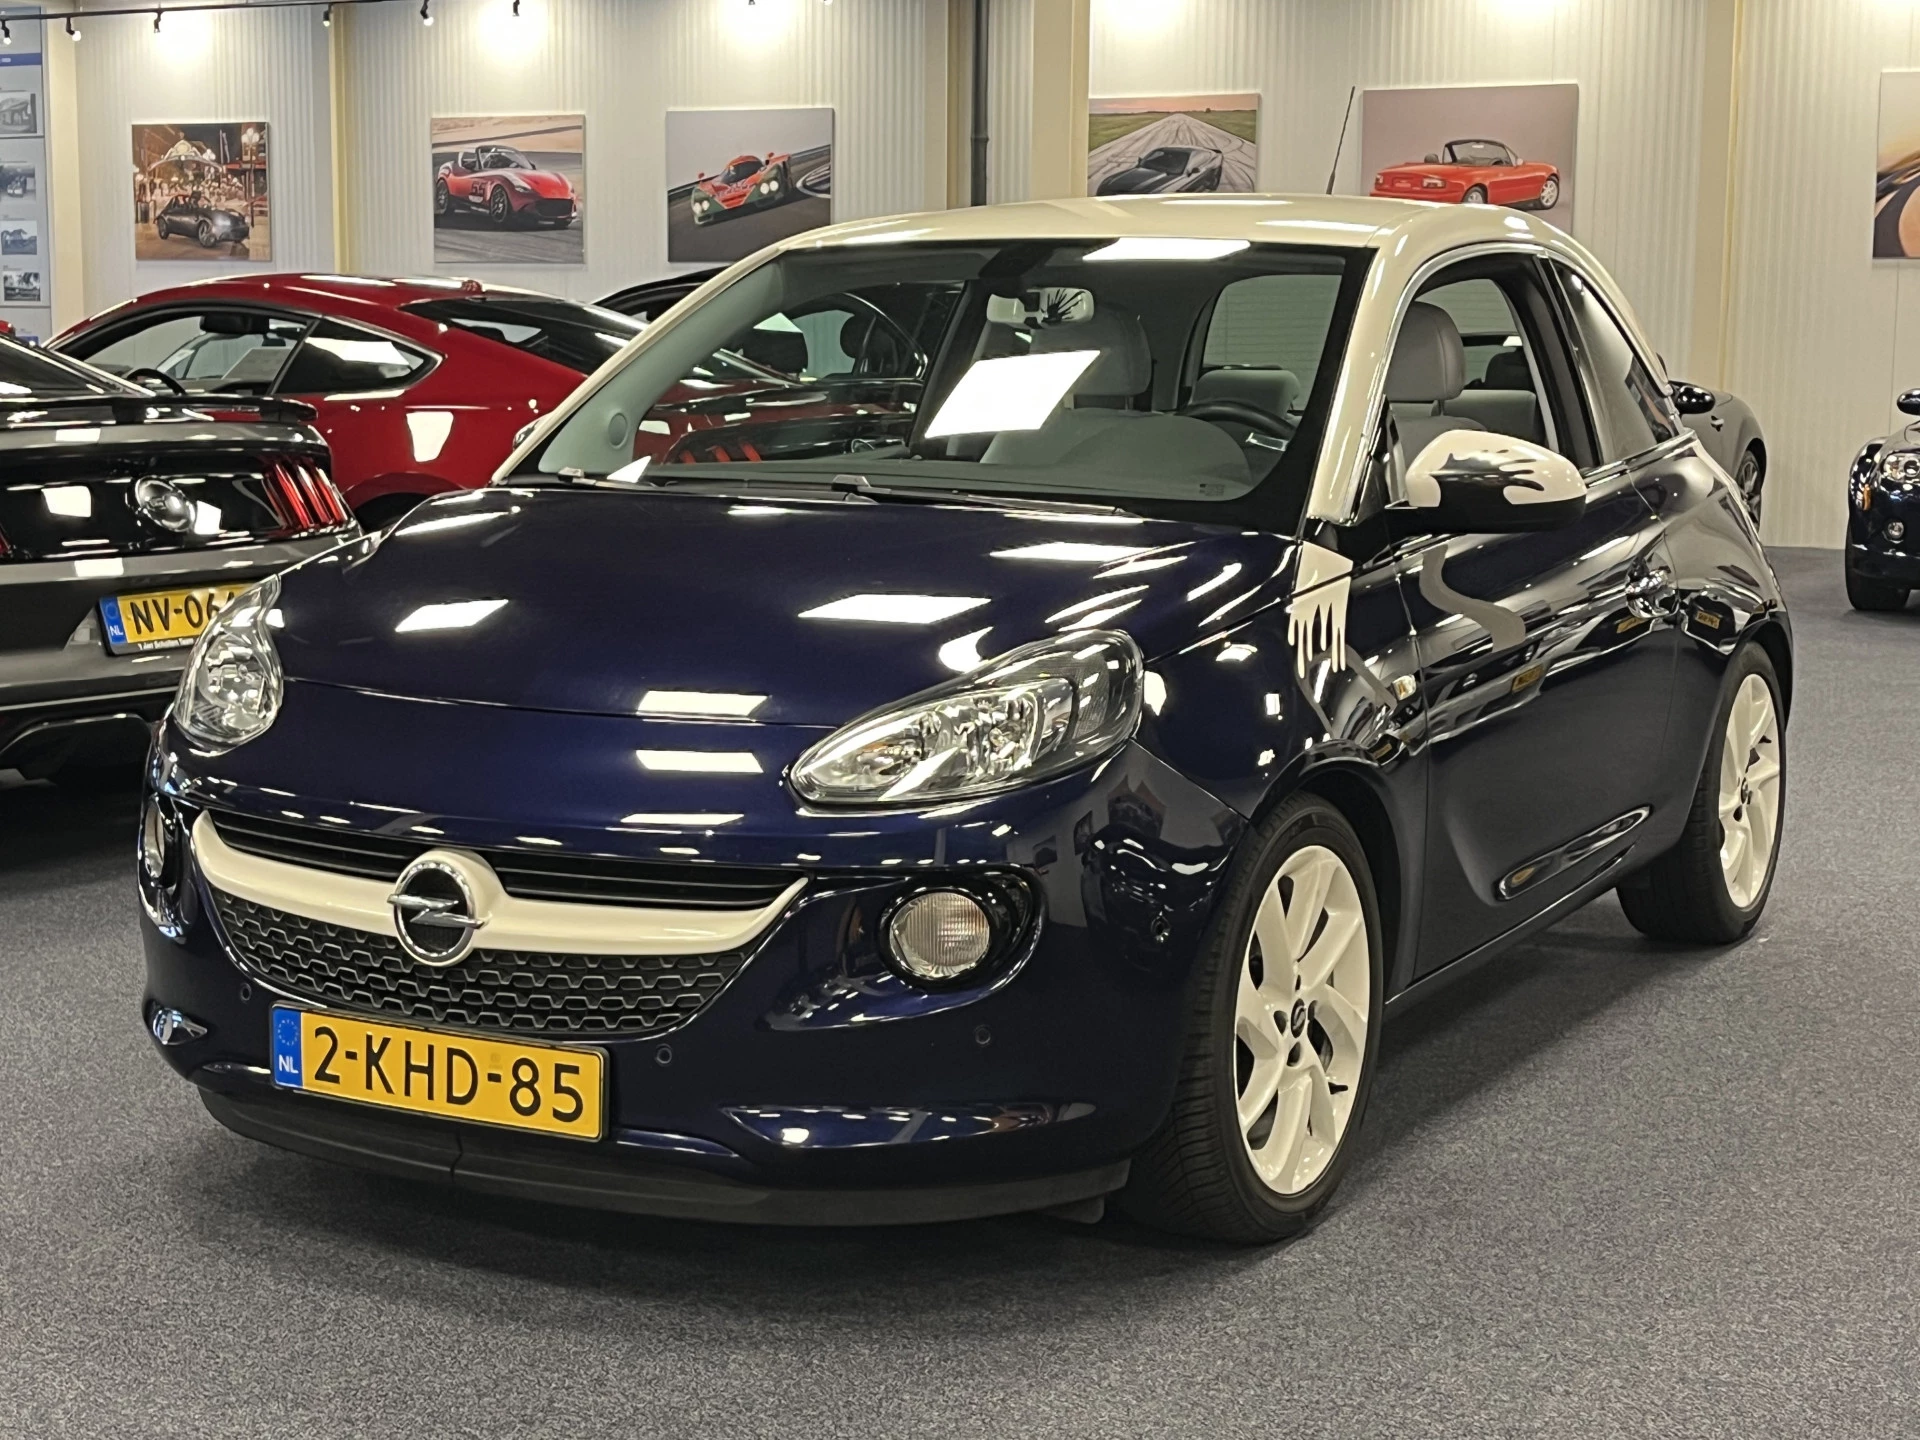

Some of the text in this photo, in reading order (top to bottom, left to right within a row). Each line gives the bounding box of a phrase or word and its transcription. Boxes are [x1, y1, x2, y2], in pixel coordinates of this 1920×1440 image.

[130, 592, 234, 634] NV-06
[109, 625, 123, 636] NL
[278, 1054, 299, 1074] NL
[314, 1026, 584, 1123] 2-KHD-85
